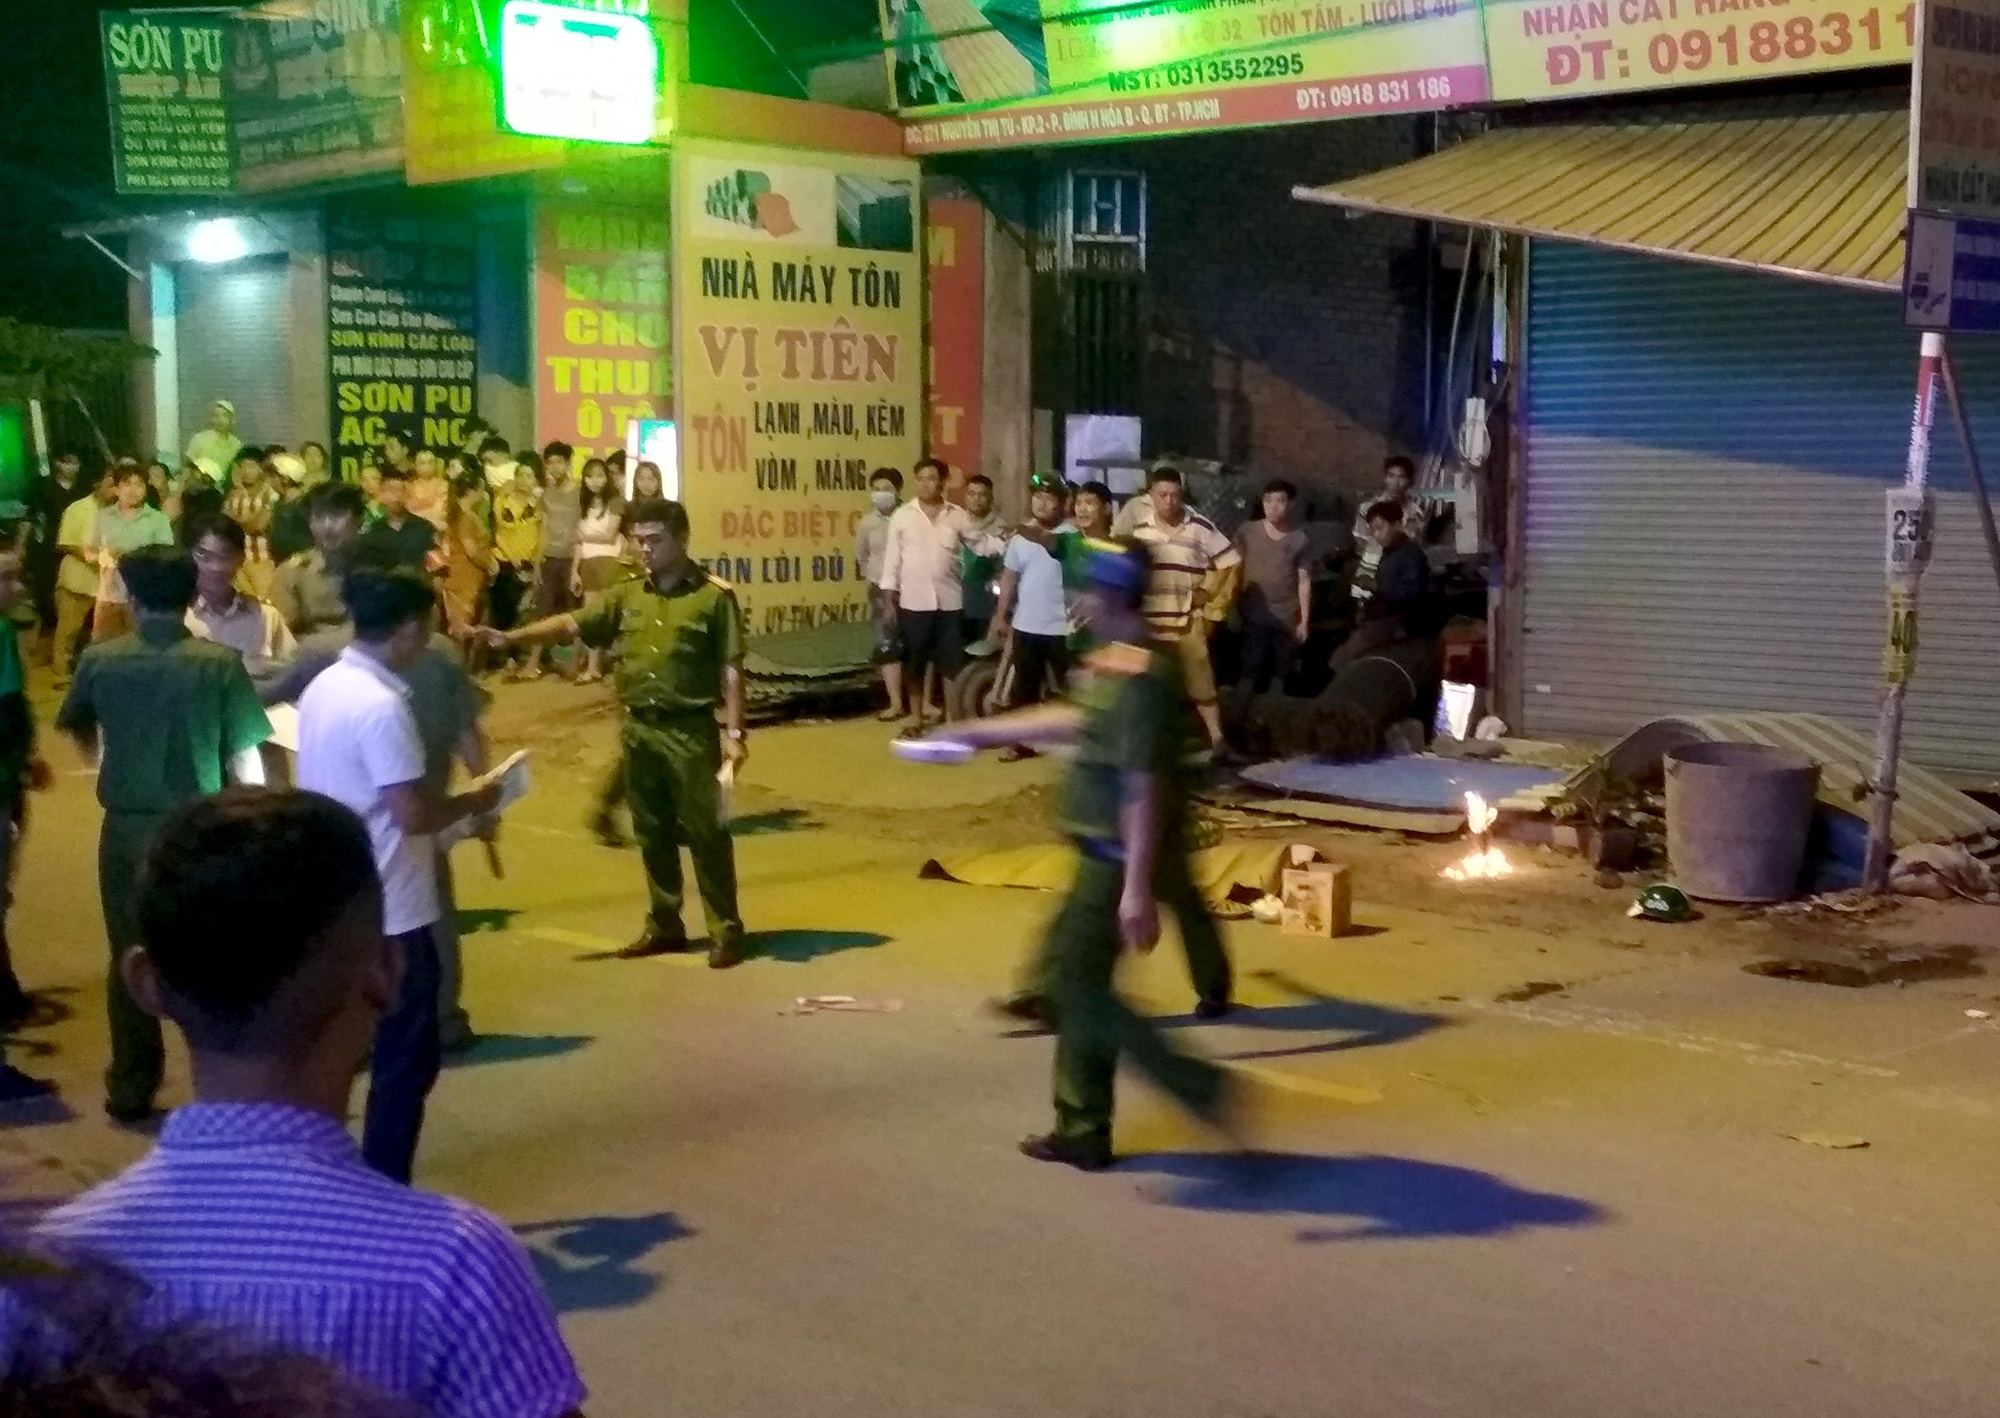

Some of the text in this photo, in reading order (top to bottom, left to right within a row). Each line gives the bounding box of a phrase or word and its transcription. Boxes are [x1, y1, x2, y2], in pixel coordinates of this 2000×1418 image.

[109, 18, 172, 70] SƠN
[181, 27, 222, 72] PU
[1546, 40, 1630, 85] ĐT:
[1108, 53, 1304, 92] MST: 0313552295
[1296, 75, 1450, 110] ĐT: 0918 831 186
[701, 251, 759, 300] NHÀ
[849, 261, 900, 309] TÔN
[699, 316, 898, 392] VỊ TIÊN
[338, 381, 472, 413] SƠN PU
[577, 399, 602, 438] Ô
[692, 403, 747, 473] TÔN
[755, 401, 800, 436] LẠNH
[756, 451, 797, 491] VÒM
[721, 504, 775, 546] ĐẶC
[783, 503, 840, 547] BIỆT
[812, 546, 844, 583] ĐỦ
